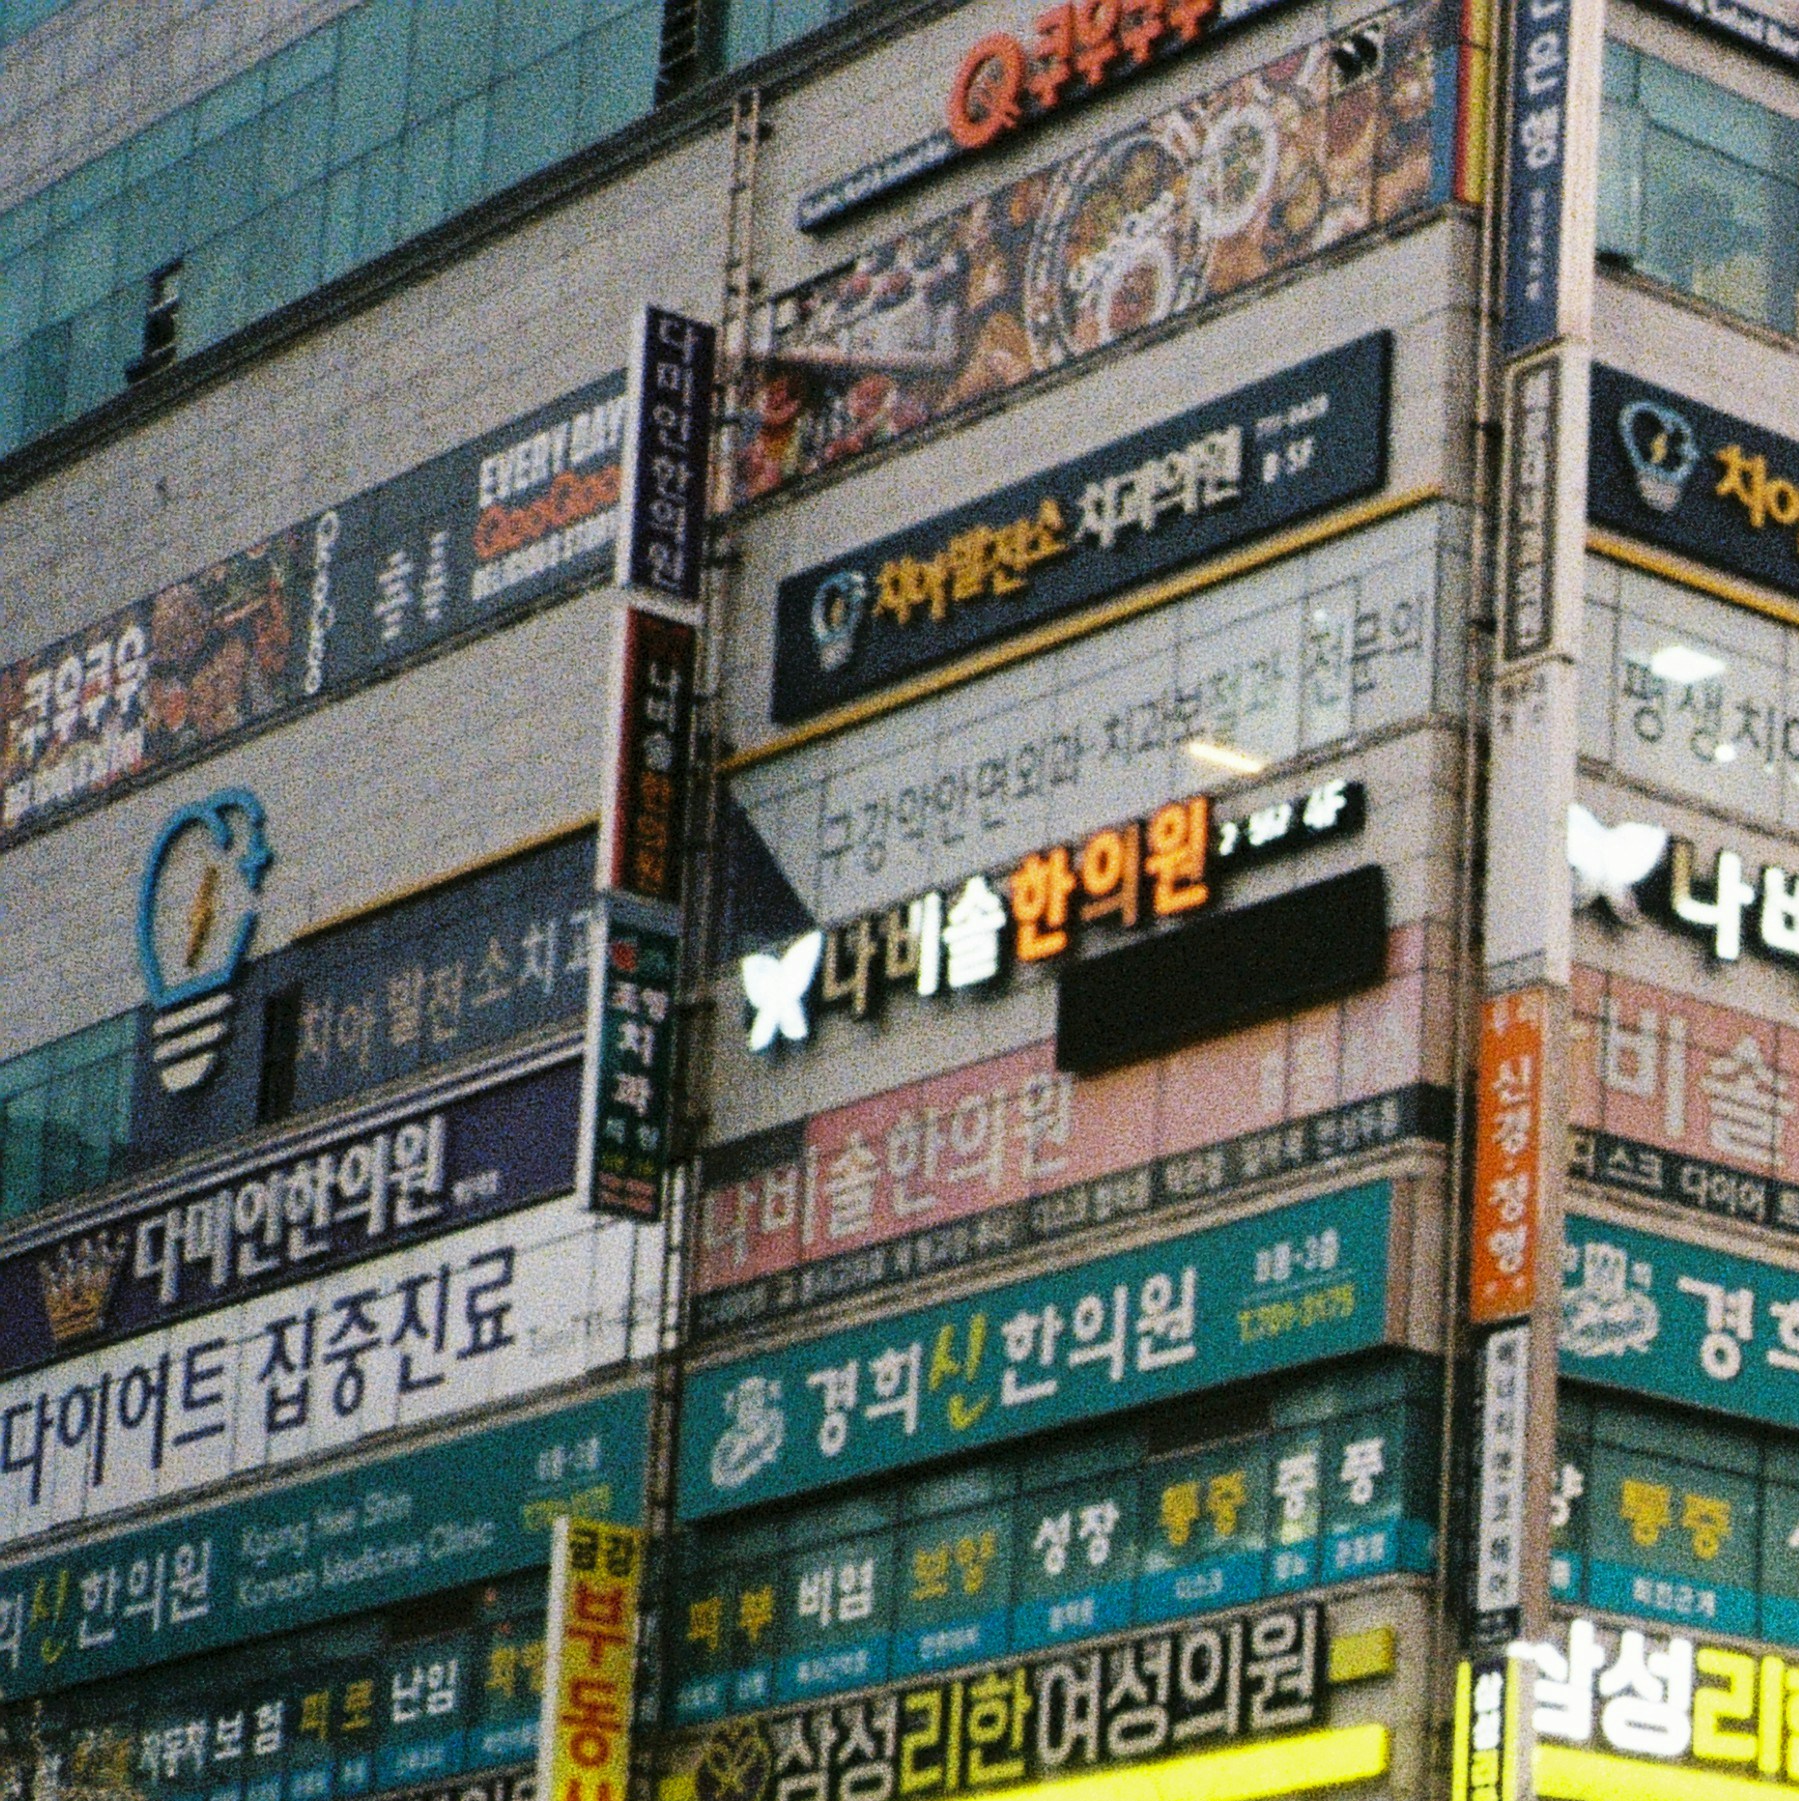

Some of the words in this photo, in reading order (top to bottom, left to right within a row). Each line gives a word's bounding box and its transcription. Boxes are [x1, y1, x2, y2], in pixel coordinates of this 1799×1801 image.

[875, 499, 1066, 617] 치아발전소
[1075, 425, 1243, 545] 치과의원
[822, 797, 1210, 1018] 나비솔한의원
[133, 1112, 449, 1305] 다미인한의원
[700, 1072, 1075, 1266] 나비솔한의원
[2, 1335, 228, 1505] 다이어트
[257, 1244, 518, 1437] 집중진료
[806, 1264, 1199, 1456] 경희신한의원
[797, 1555, 876, 1630] 비염
[1032, 1501, 1121, 1577] 성장
[392, 1656, 458, 1724] 난임
